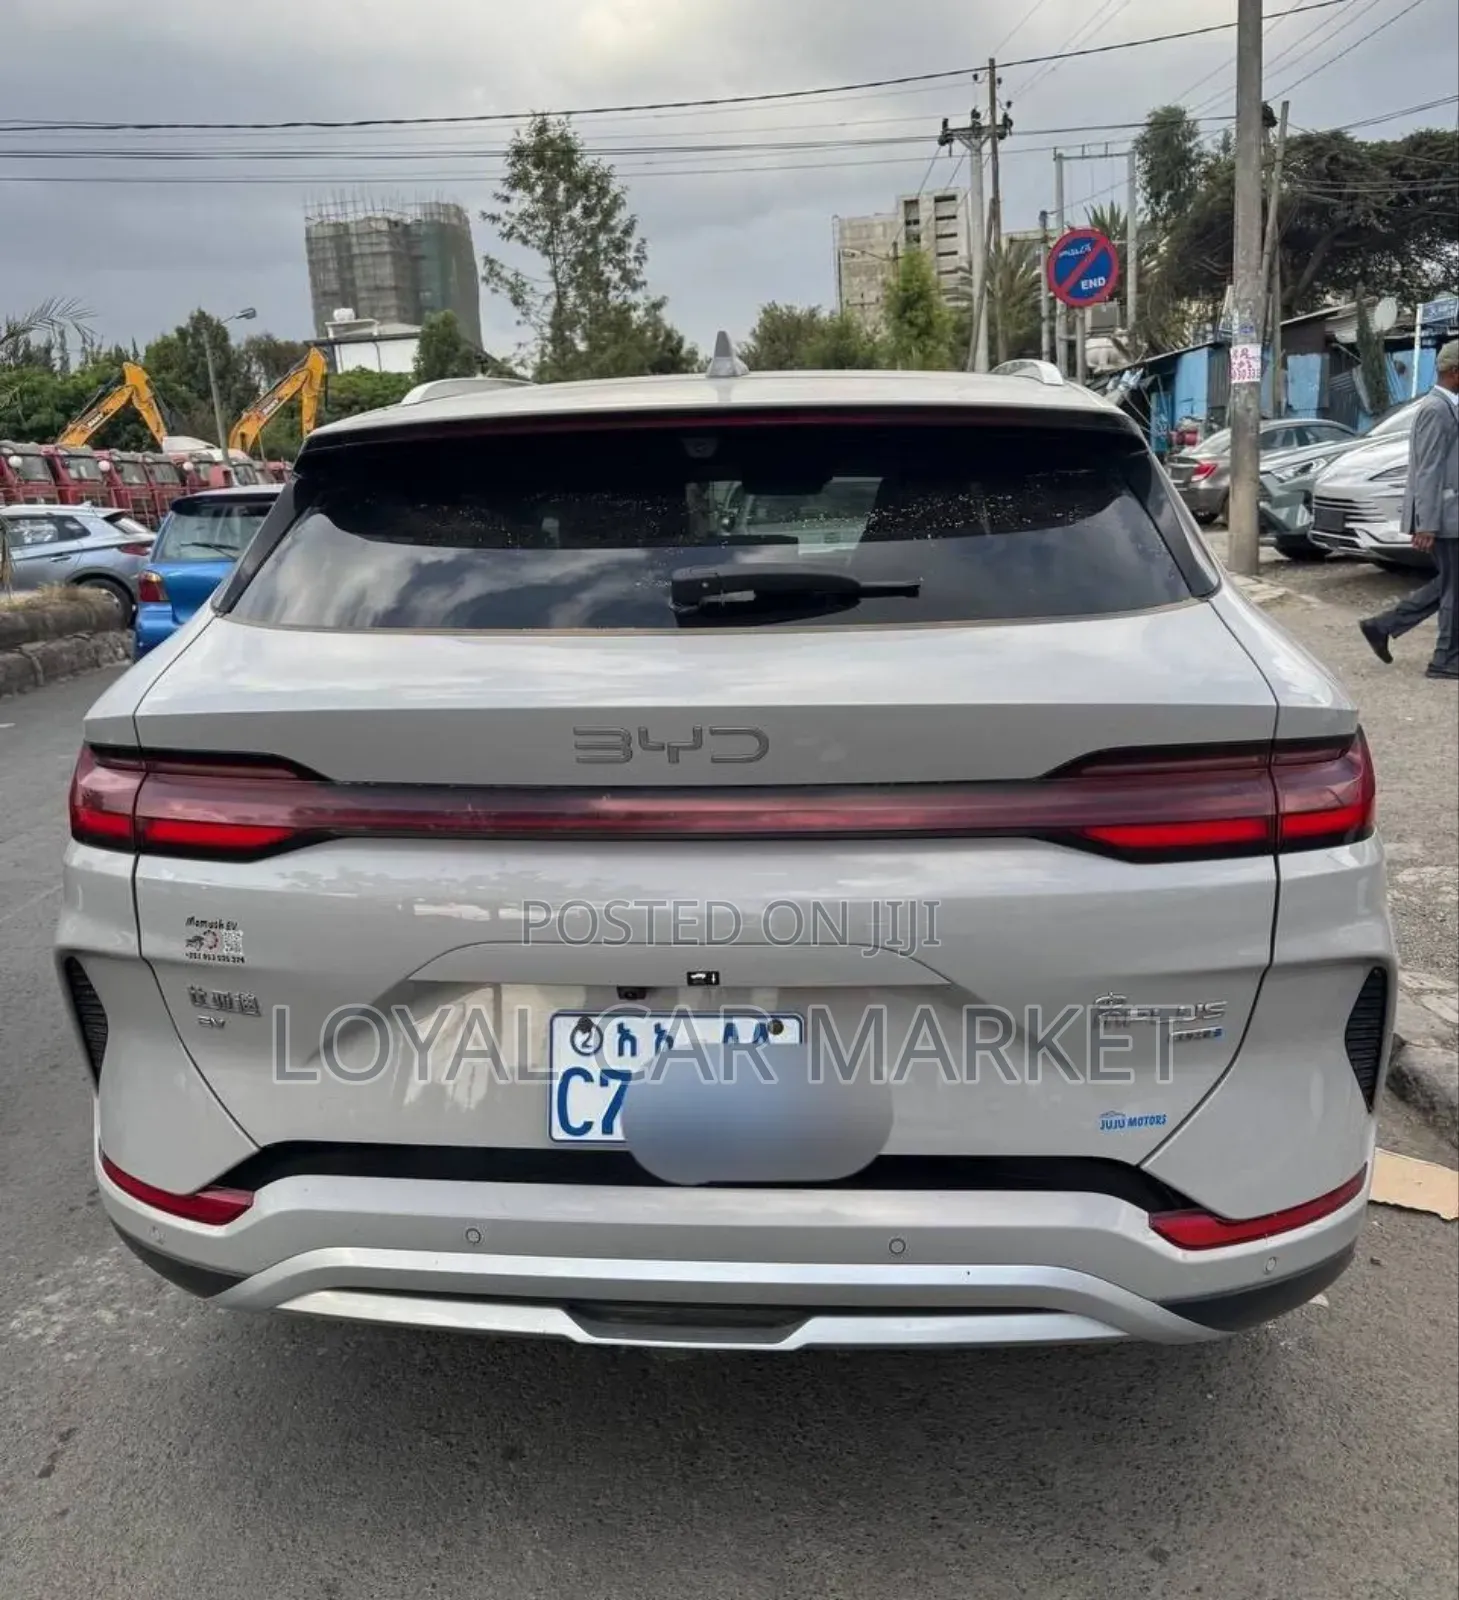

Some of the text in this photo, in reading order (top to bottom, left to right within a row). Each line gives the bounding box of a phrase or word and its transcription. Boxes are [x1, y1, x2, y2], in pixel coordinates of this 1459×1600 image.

[1081, 276, 1106, 290] END
[573, 725, 769, 764] BYD
[1099, 1114, 1167, 1131] JUJU MOTORS
